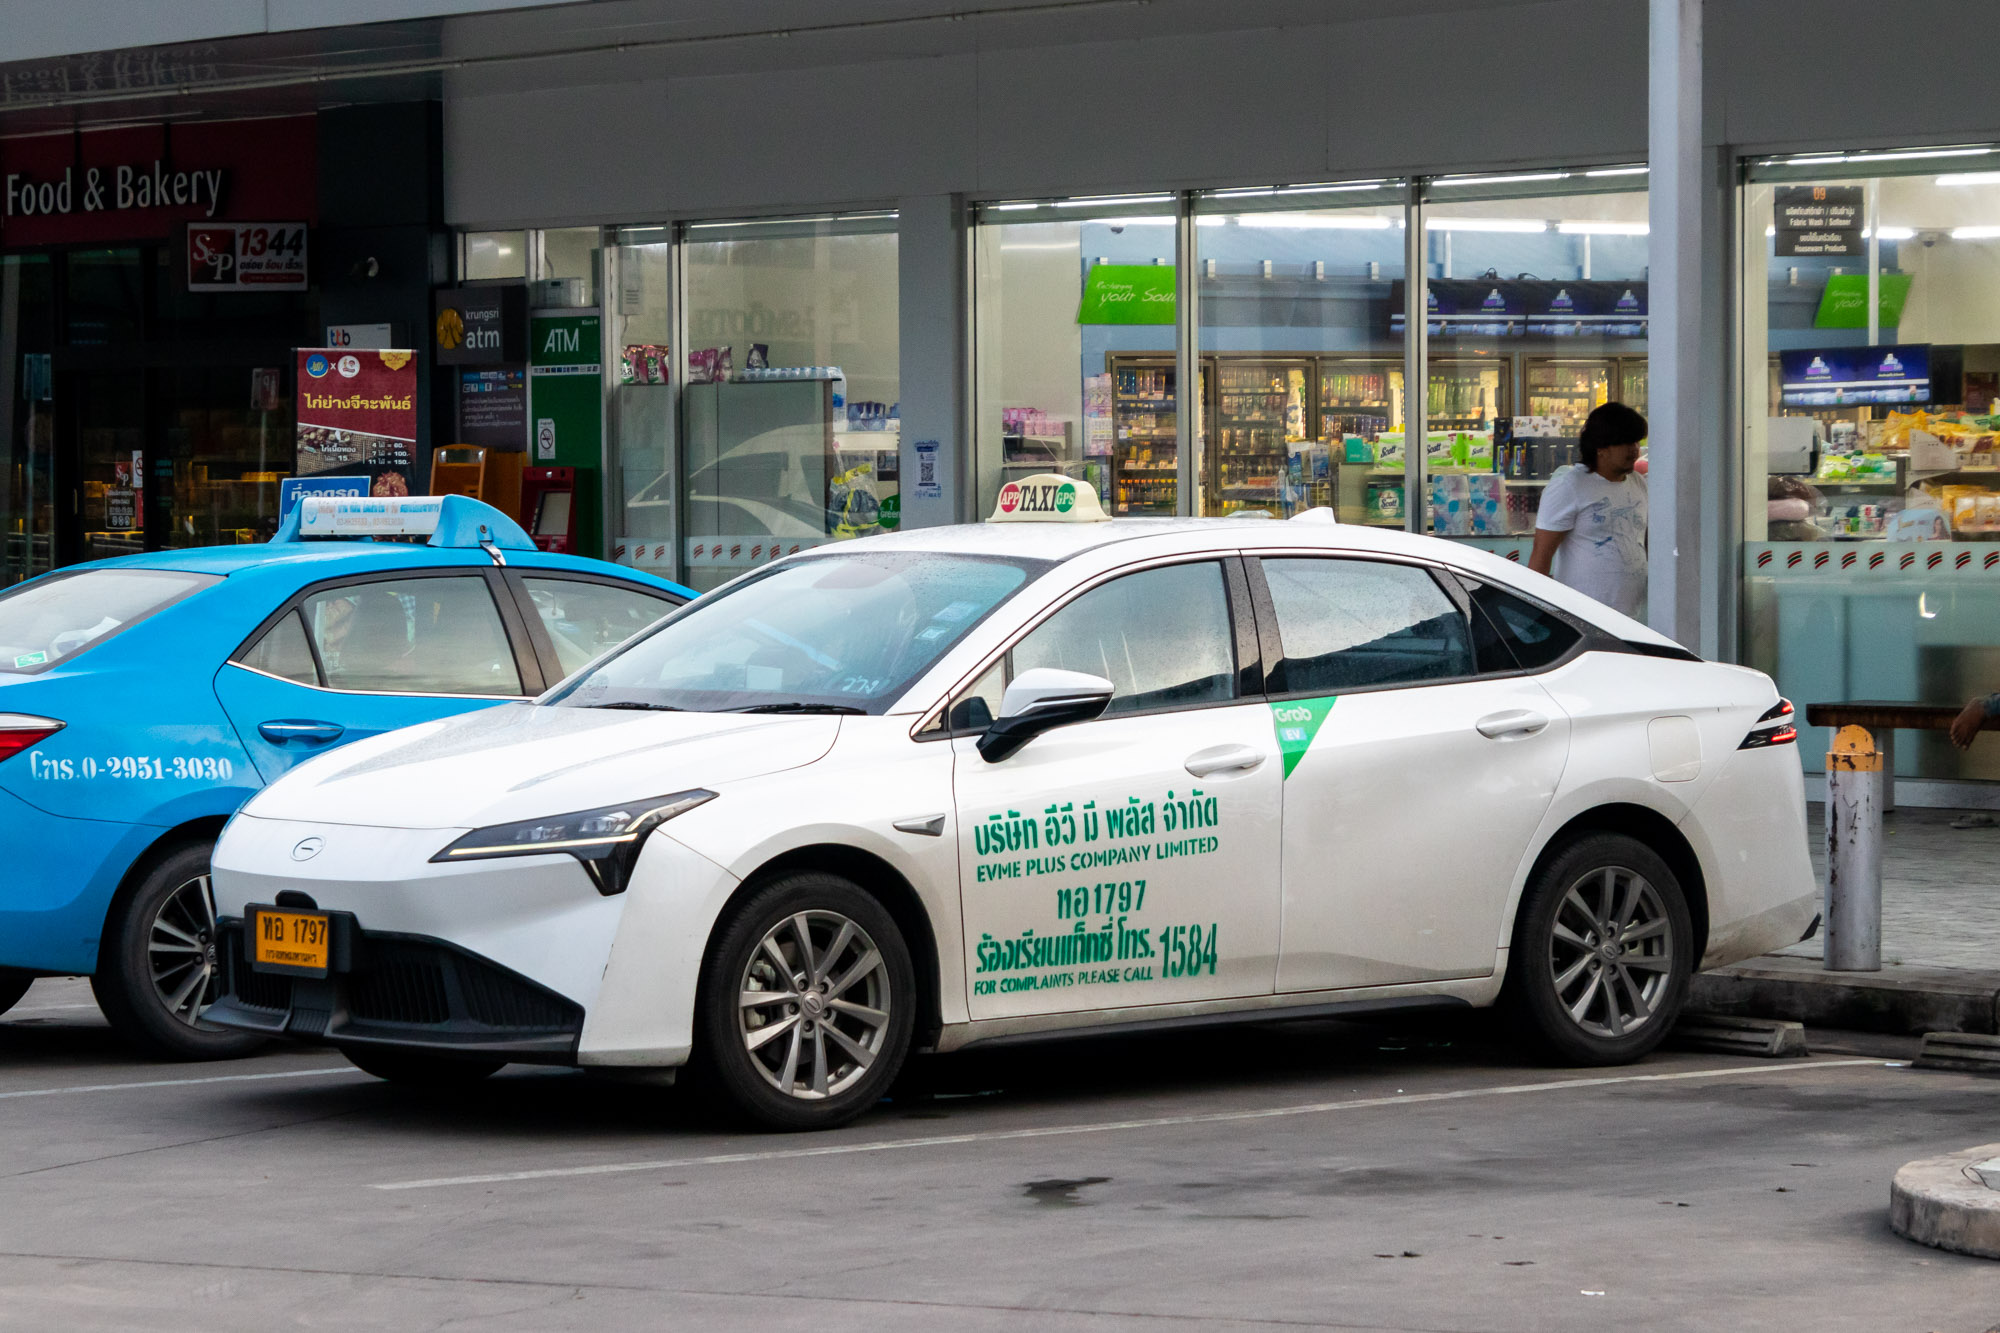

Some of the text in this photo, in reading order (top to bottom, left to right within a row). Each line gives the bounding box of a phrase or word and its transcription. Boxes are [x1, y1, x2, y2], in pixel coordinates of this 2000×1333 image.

[6, 160, 223, 218] Food & Bakery
[1813, 187, 1826, 200] 09
[1790, 218, 1807, 226] Fabric
[1808, 218, 1824, 226] Wash
[1829, 218, 1851, 226] Softener
[240, 229, 303, 256] 1344
[1794, 244, 1847, 252] Houseware Products
[1098, 292, 1137, 308] your
[465, 307, 499, 321] krungsri
[331, 329, 350, 346] ttb
[466, 326, 500, 349] atm
[543, 327, 579, 353] ATM
[303, 392, 411, 410] ไก่ย่างจีระพันธ์
[1381, 445, 1397, 458] Scott
[1427, 443, 1442, 454] Scott
[1472, 447, 1484, 456] Scott
[888, 499, 895, 511] 7
[1001, 485, 1075, 512] APP TAXI GPS
[1381, 499, 1397, 509] Scott
[1274, 706, 1313, 722] Grab
[1285, 729, 1301, 740] EV
[974, 809, 1039, 856] บริษัท
[1044, 802, 1076, 847] อีวี
[1105, 796, 1155, 839] พลัส
[1162, 788, 1218, 832] จำกัด
[976, 836, 1218, 883] EVME PLUS COMPANY LIMITED
[263, 916, 327, 945] ทอ 1797
[1159, 923, 1217, 979] 1584
[974, 966, 1153, 996] FOR COMPLAINTS PLEASE CALL
